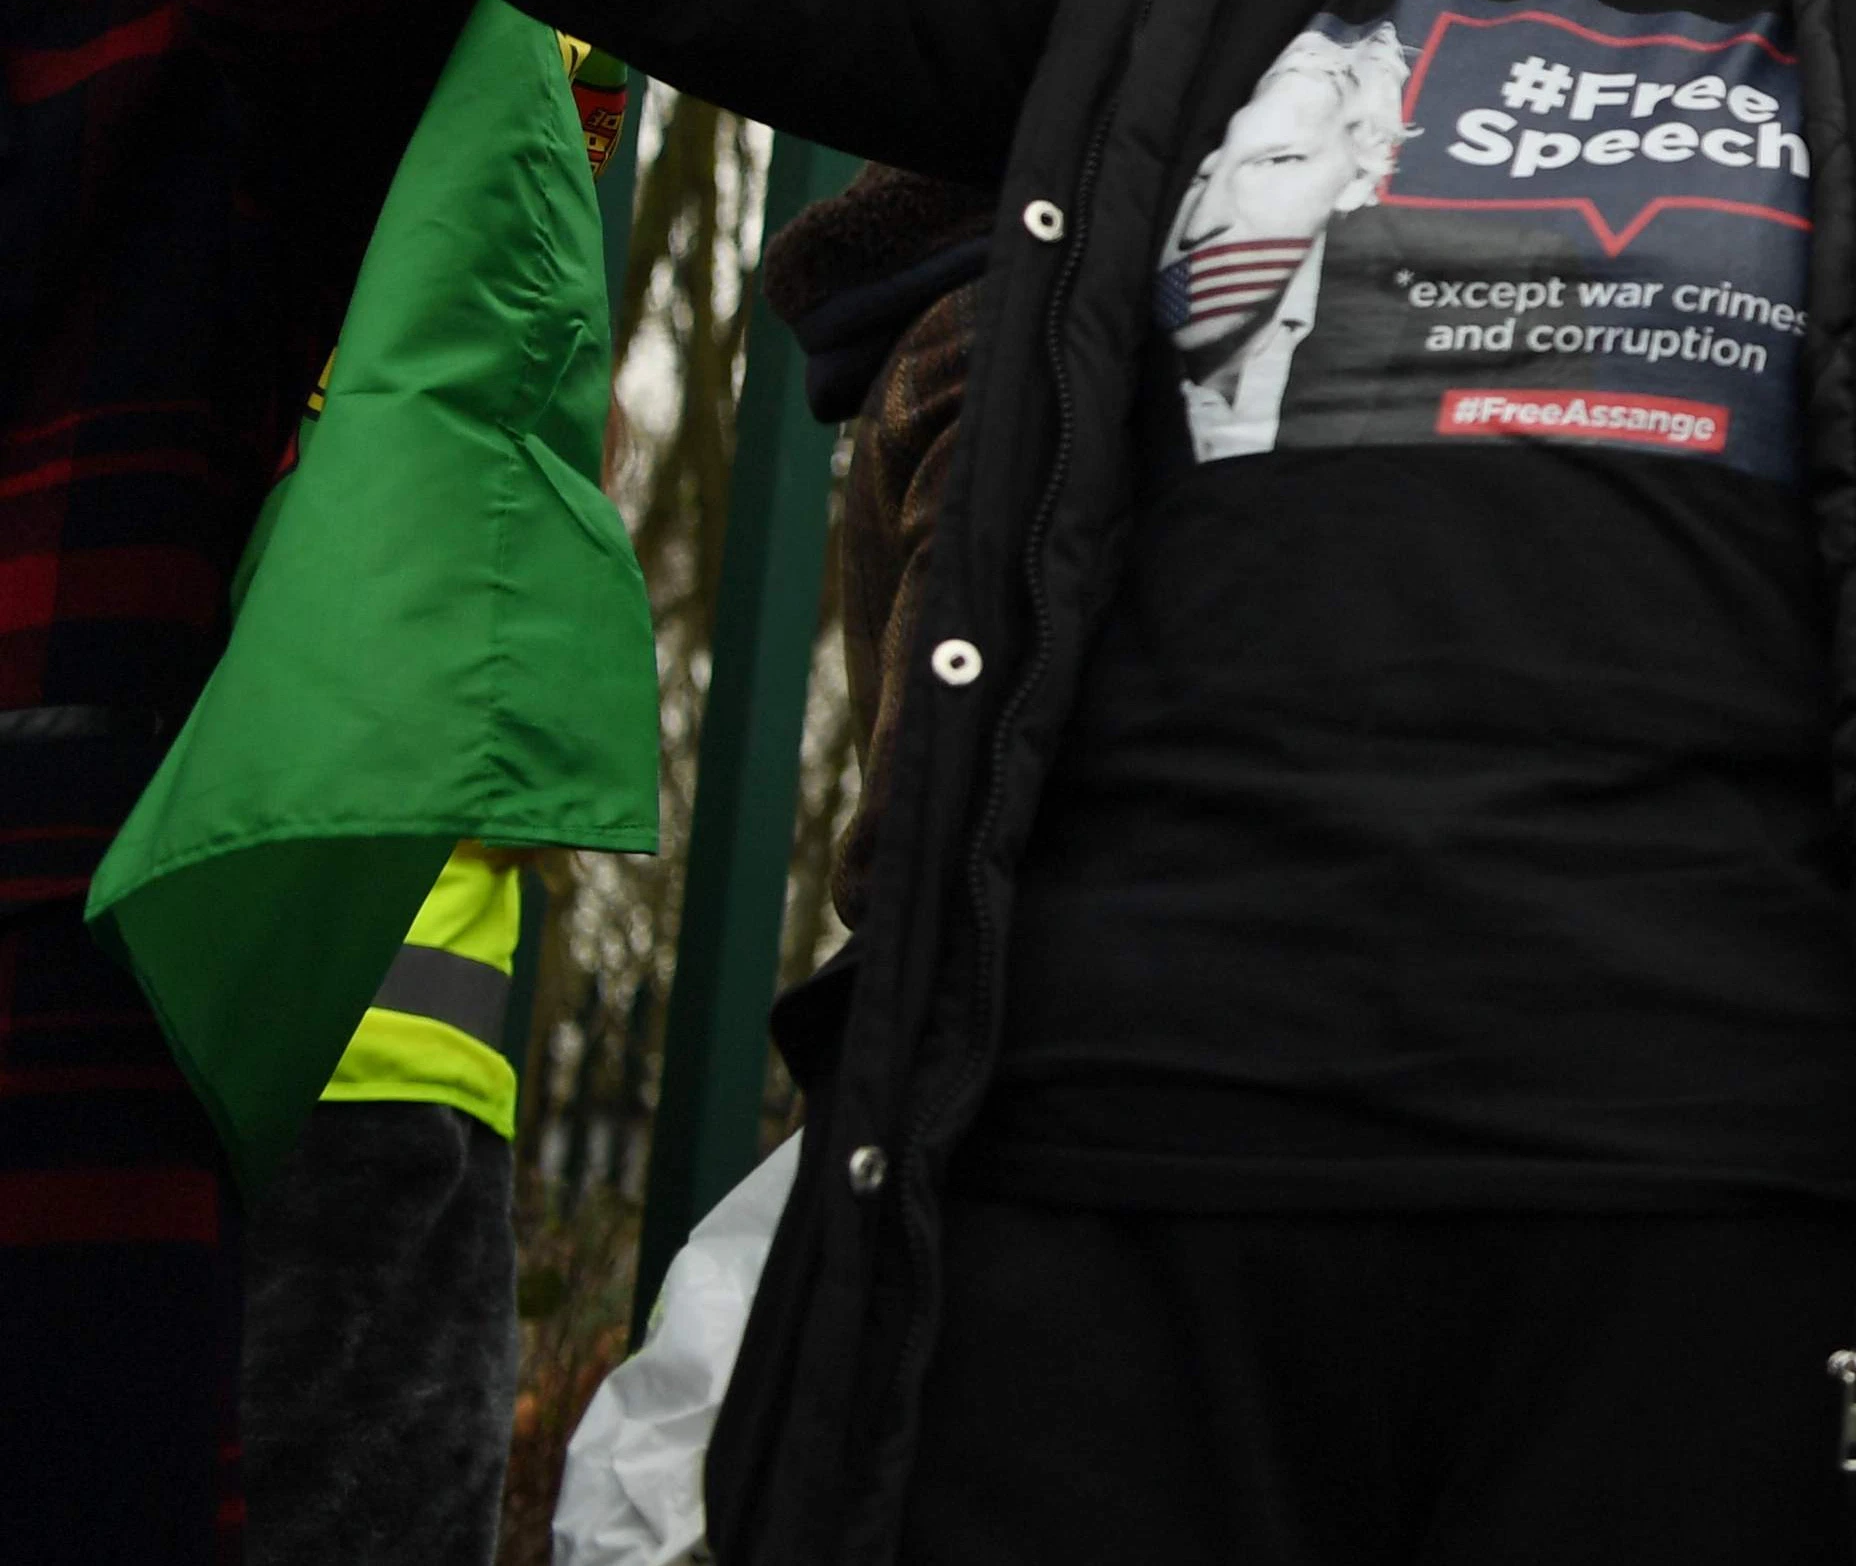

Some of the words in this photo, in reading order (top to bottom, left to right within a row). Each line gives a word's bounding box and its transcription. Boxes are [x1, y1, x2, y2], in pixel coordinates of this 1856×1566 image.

[1501, 56, 1779, 124] #Free
[1447, 108, 1811, 178] Speech
[1578, 282, 1664, 309] war
[1425, 317, 1517, 352] and
[1525, 324, 1768, 373] corruption
[1452, 392, 1717, 442] #FreeAssange
